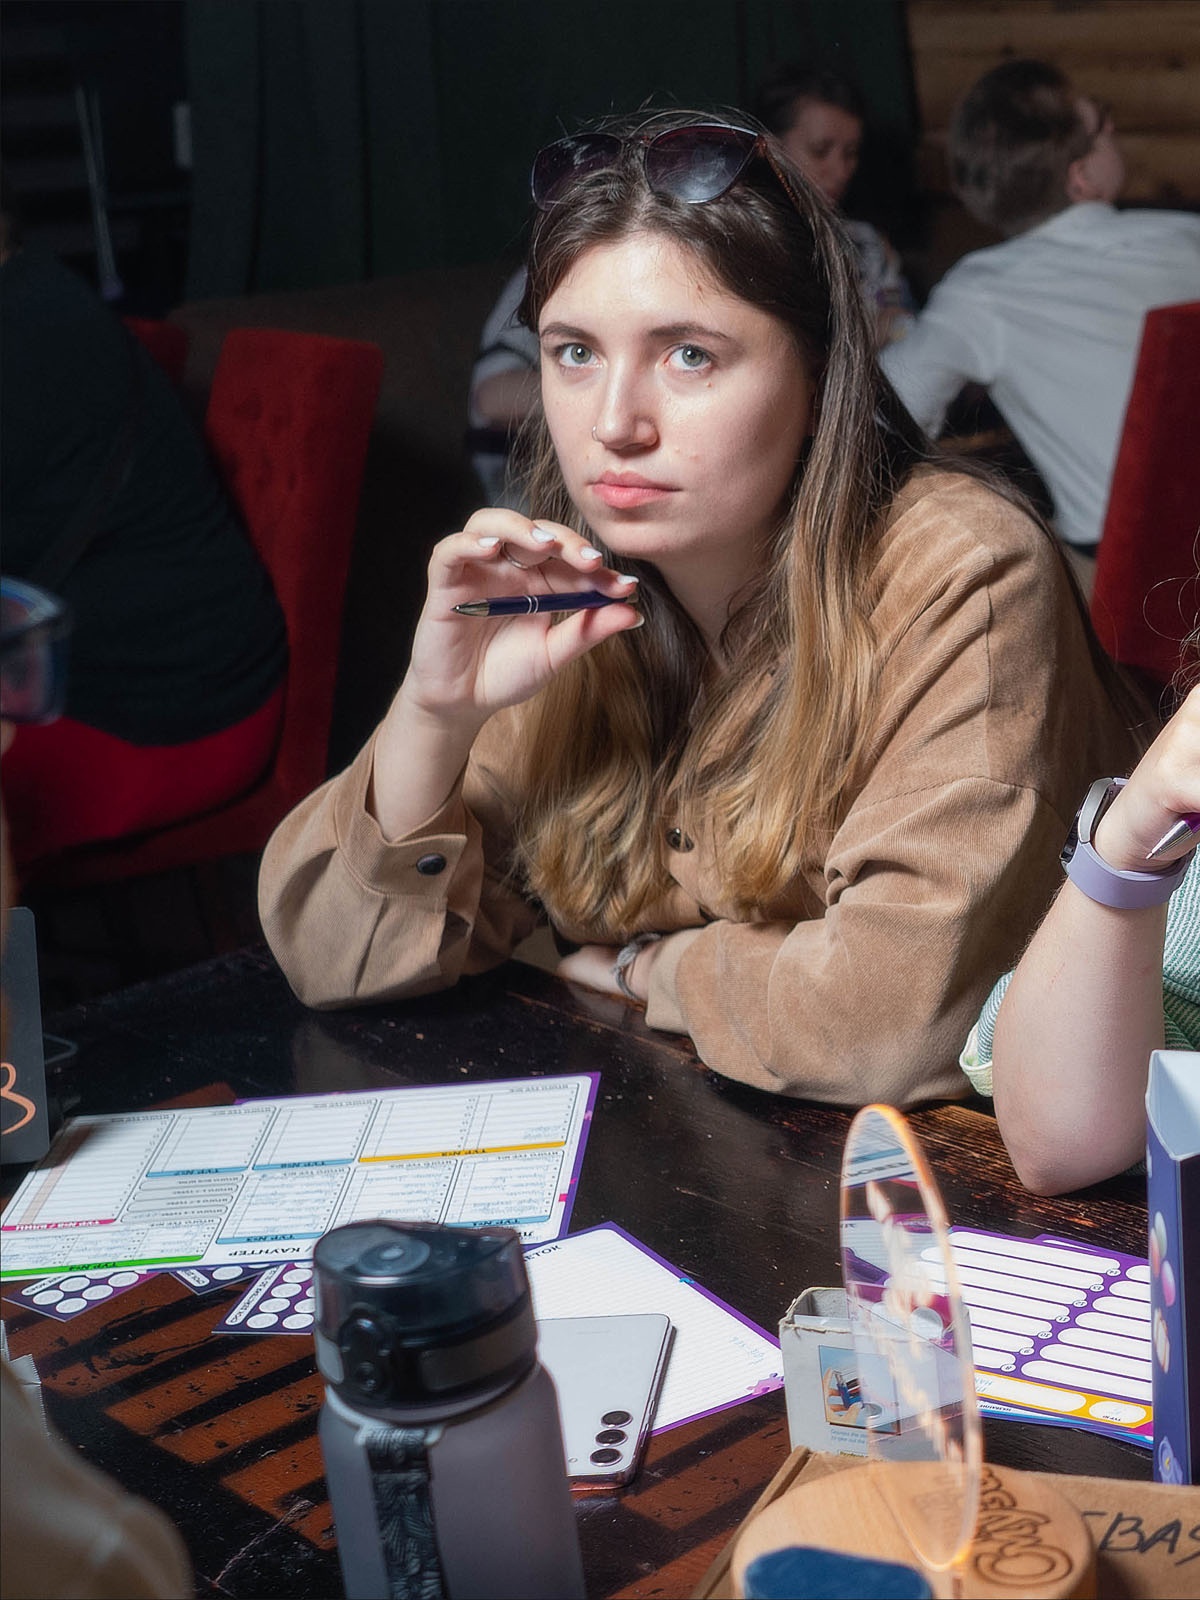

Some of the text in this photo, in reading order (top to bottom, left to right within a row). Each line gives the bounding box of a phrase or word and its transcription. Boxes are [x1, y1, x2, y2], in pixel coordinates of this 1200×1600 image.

[472, 1218, 520, 1228] ТУР №1
[227, 1246, 301, 1257] КАУНТЕР
[94, 1261, 117, 1270] ТУР
